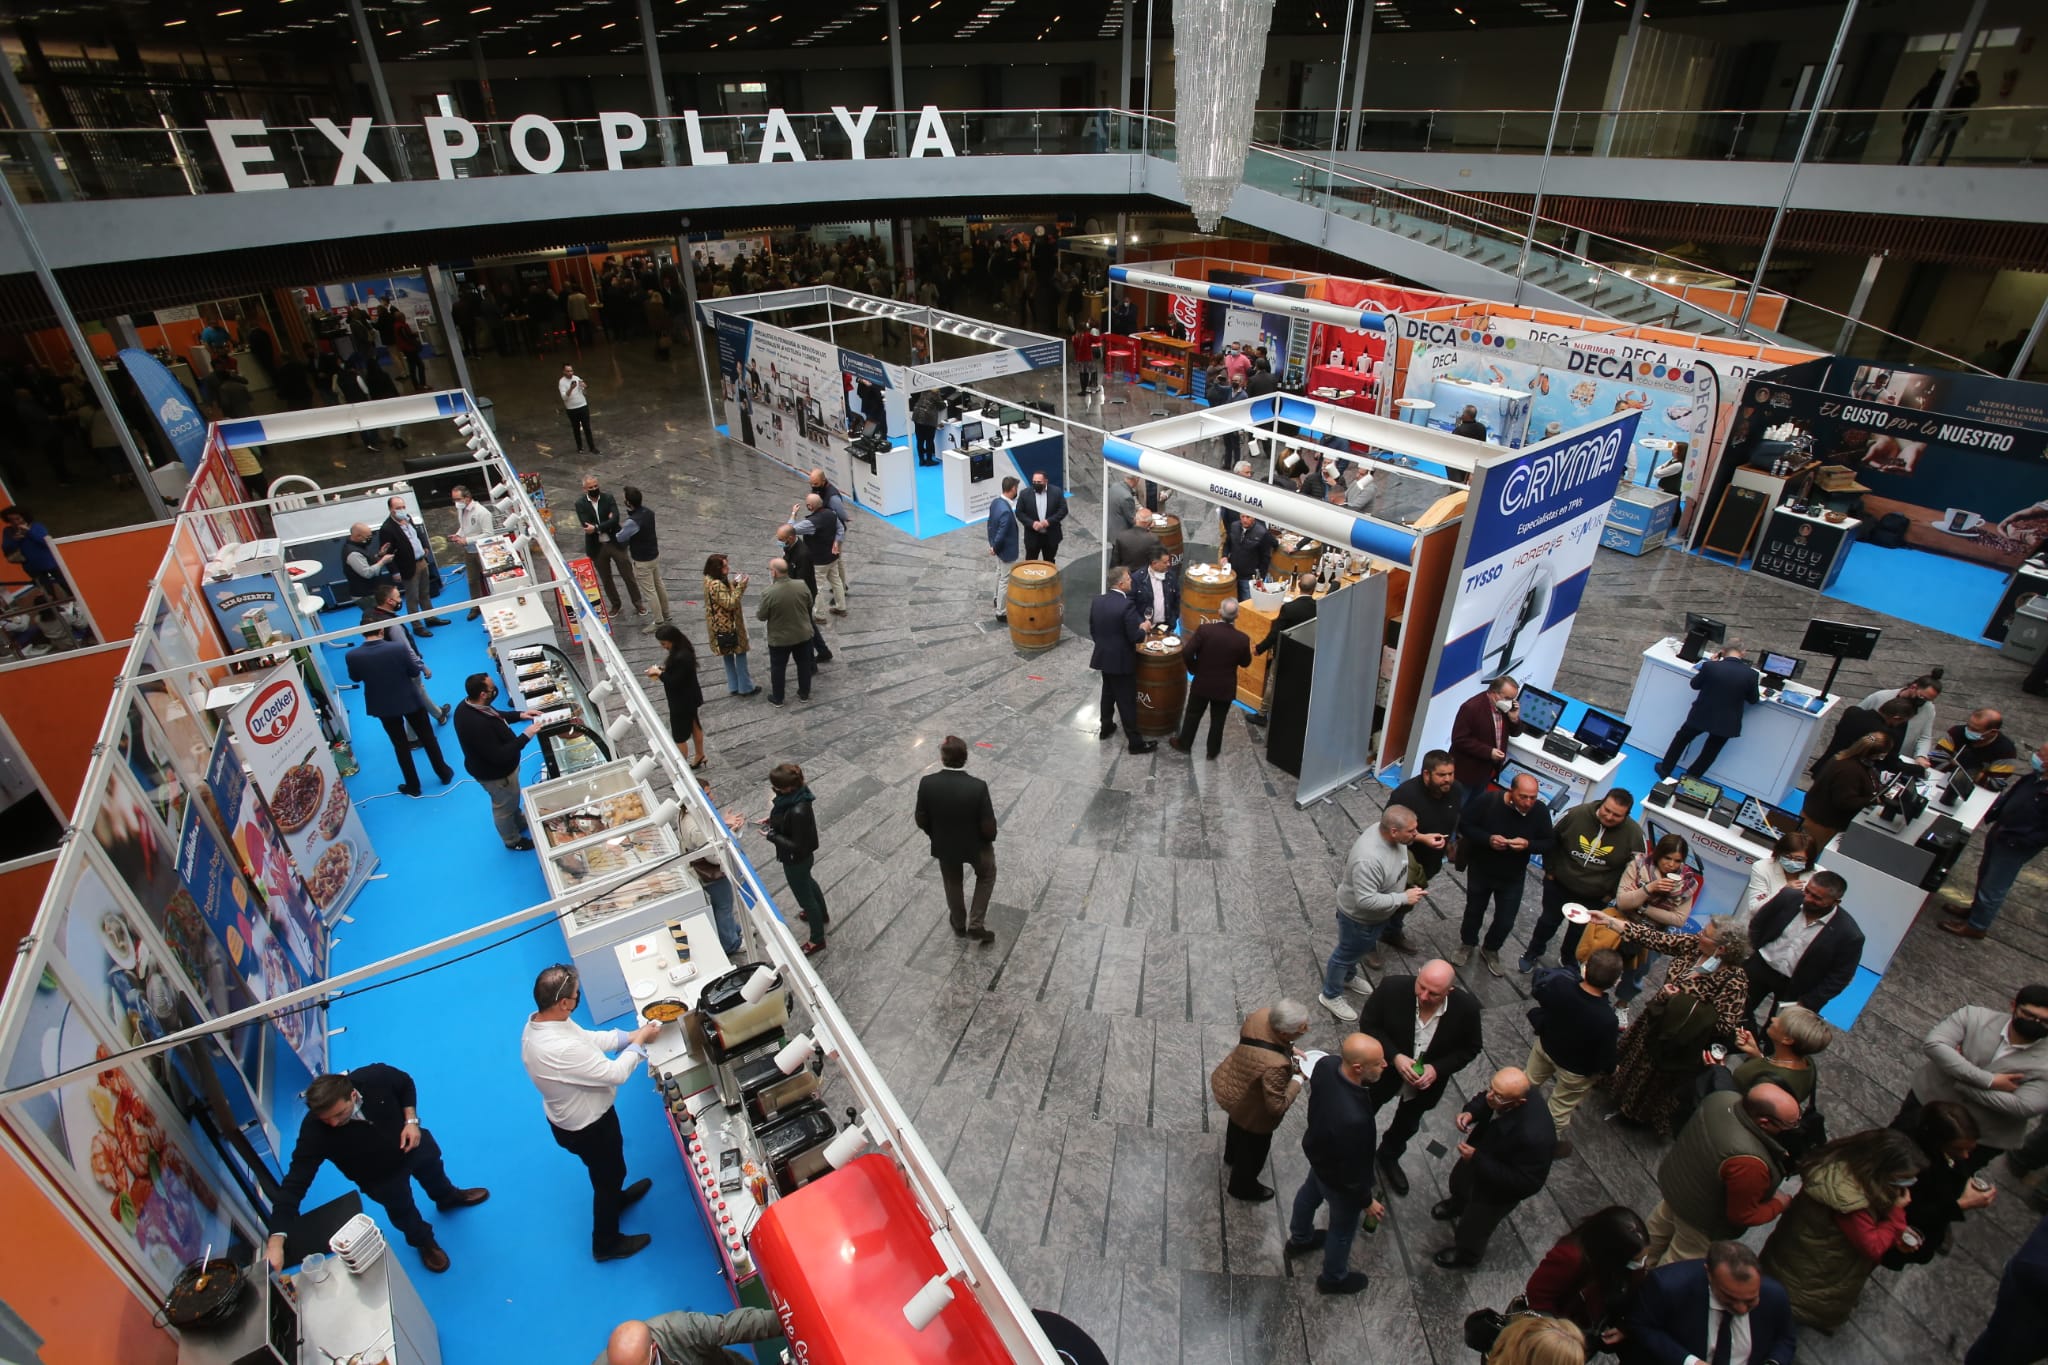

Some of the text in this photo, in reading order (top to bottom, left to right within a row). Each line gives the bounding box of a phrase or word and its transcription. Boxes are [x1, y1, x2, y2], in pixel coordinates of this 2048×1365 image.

[206, 105, 956, 192] EXPOPLAYA
[1406, 320, 1457, 347] DECA
[1574, 342, 1615, 356] NURIMAR
[1432, 352, 1458, 369] DECA
[1568, 350, 1633, 382] DECA
[1695, 376, 1712, 434] DECA
[1819, 402, 1839, 418] El
[1841, 405, 1889, 428] GUSTO
[1885, 416, 1918, 431] por
[1937, 424, 2014, 452] NUESTRO
[1499, 428, 1622, 516] CRYMA
[1209, 483, 1263, 508] BODEGAS LARA
[1517, 497, 1584, 535] Especialistas en TPVs
[1465, 563, 1504, 593] TYSSO
[1571, 850, 1606, 865] adidas
[778, 1298, 795, 1340] The
